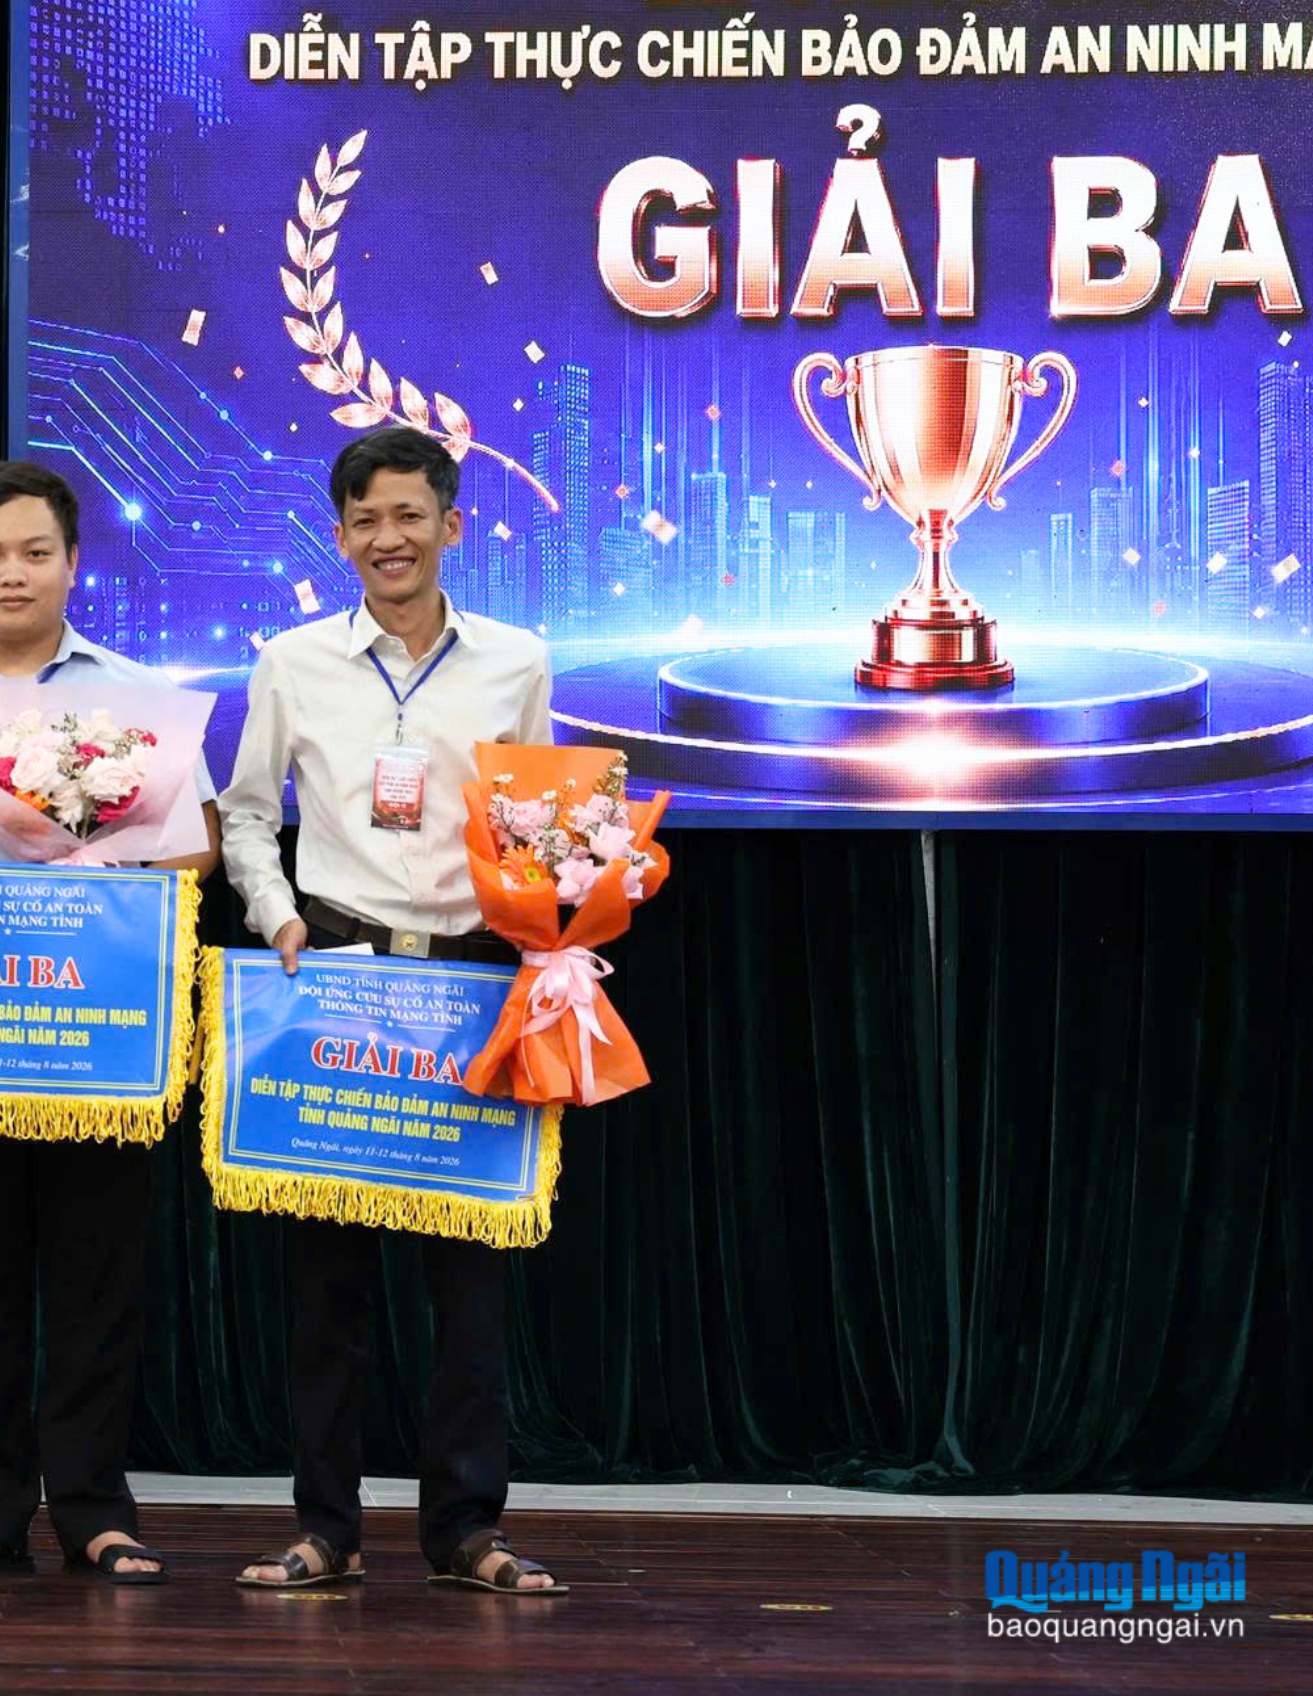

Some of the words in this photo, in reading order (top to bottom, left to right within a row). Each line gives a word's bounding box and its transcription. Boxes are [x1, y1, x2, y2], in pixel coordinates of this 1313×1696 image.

[249, 12, 360, 80] DIỄN
[375, 20, 472, 90] TẬP
[485, 25, 623, 90] THỰC
[637, 12, 785, 78] CHIẾN
[801, 13, 902, 76] BẢO
[916, 12, 1026, 75] ĐẢM
[1040, 25, 1111, 74] AN
[1125, 23, 1247, 72] NINH
[1262, 21, 1313, 70] M
[597, 103, 977, 318] GIẢI
[1050, 153, 1303, 318] BA
[44, 902, 64, 914] AN
[27, 955, 85, 989] BA
[316, 974, 351, 986] UBND
[366, 1005, 387, 1017] TIN
[423, 998, 444, 1011] AN
[55, 1007, 72, 1023] AN
[75, 1007, 106, 1024] NINH
[109, 1008, 147, 1029] MẠNG
[59, 1029, 90, 1047] 2026
[311, 1032, 403, 1078] GIẢI
[408, 1048, 462, 1085] BA
[336, 1087, 372, 1108] CHIẾN
[431, 1102, 448, 1118] AN
[450, 1104, 479, 1122] NINH
[481, 1107, 516, 1128] MẠNG
[432, 1125, 461, 1142] 2026
